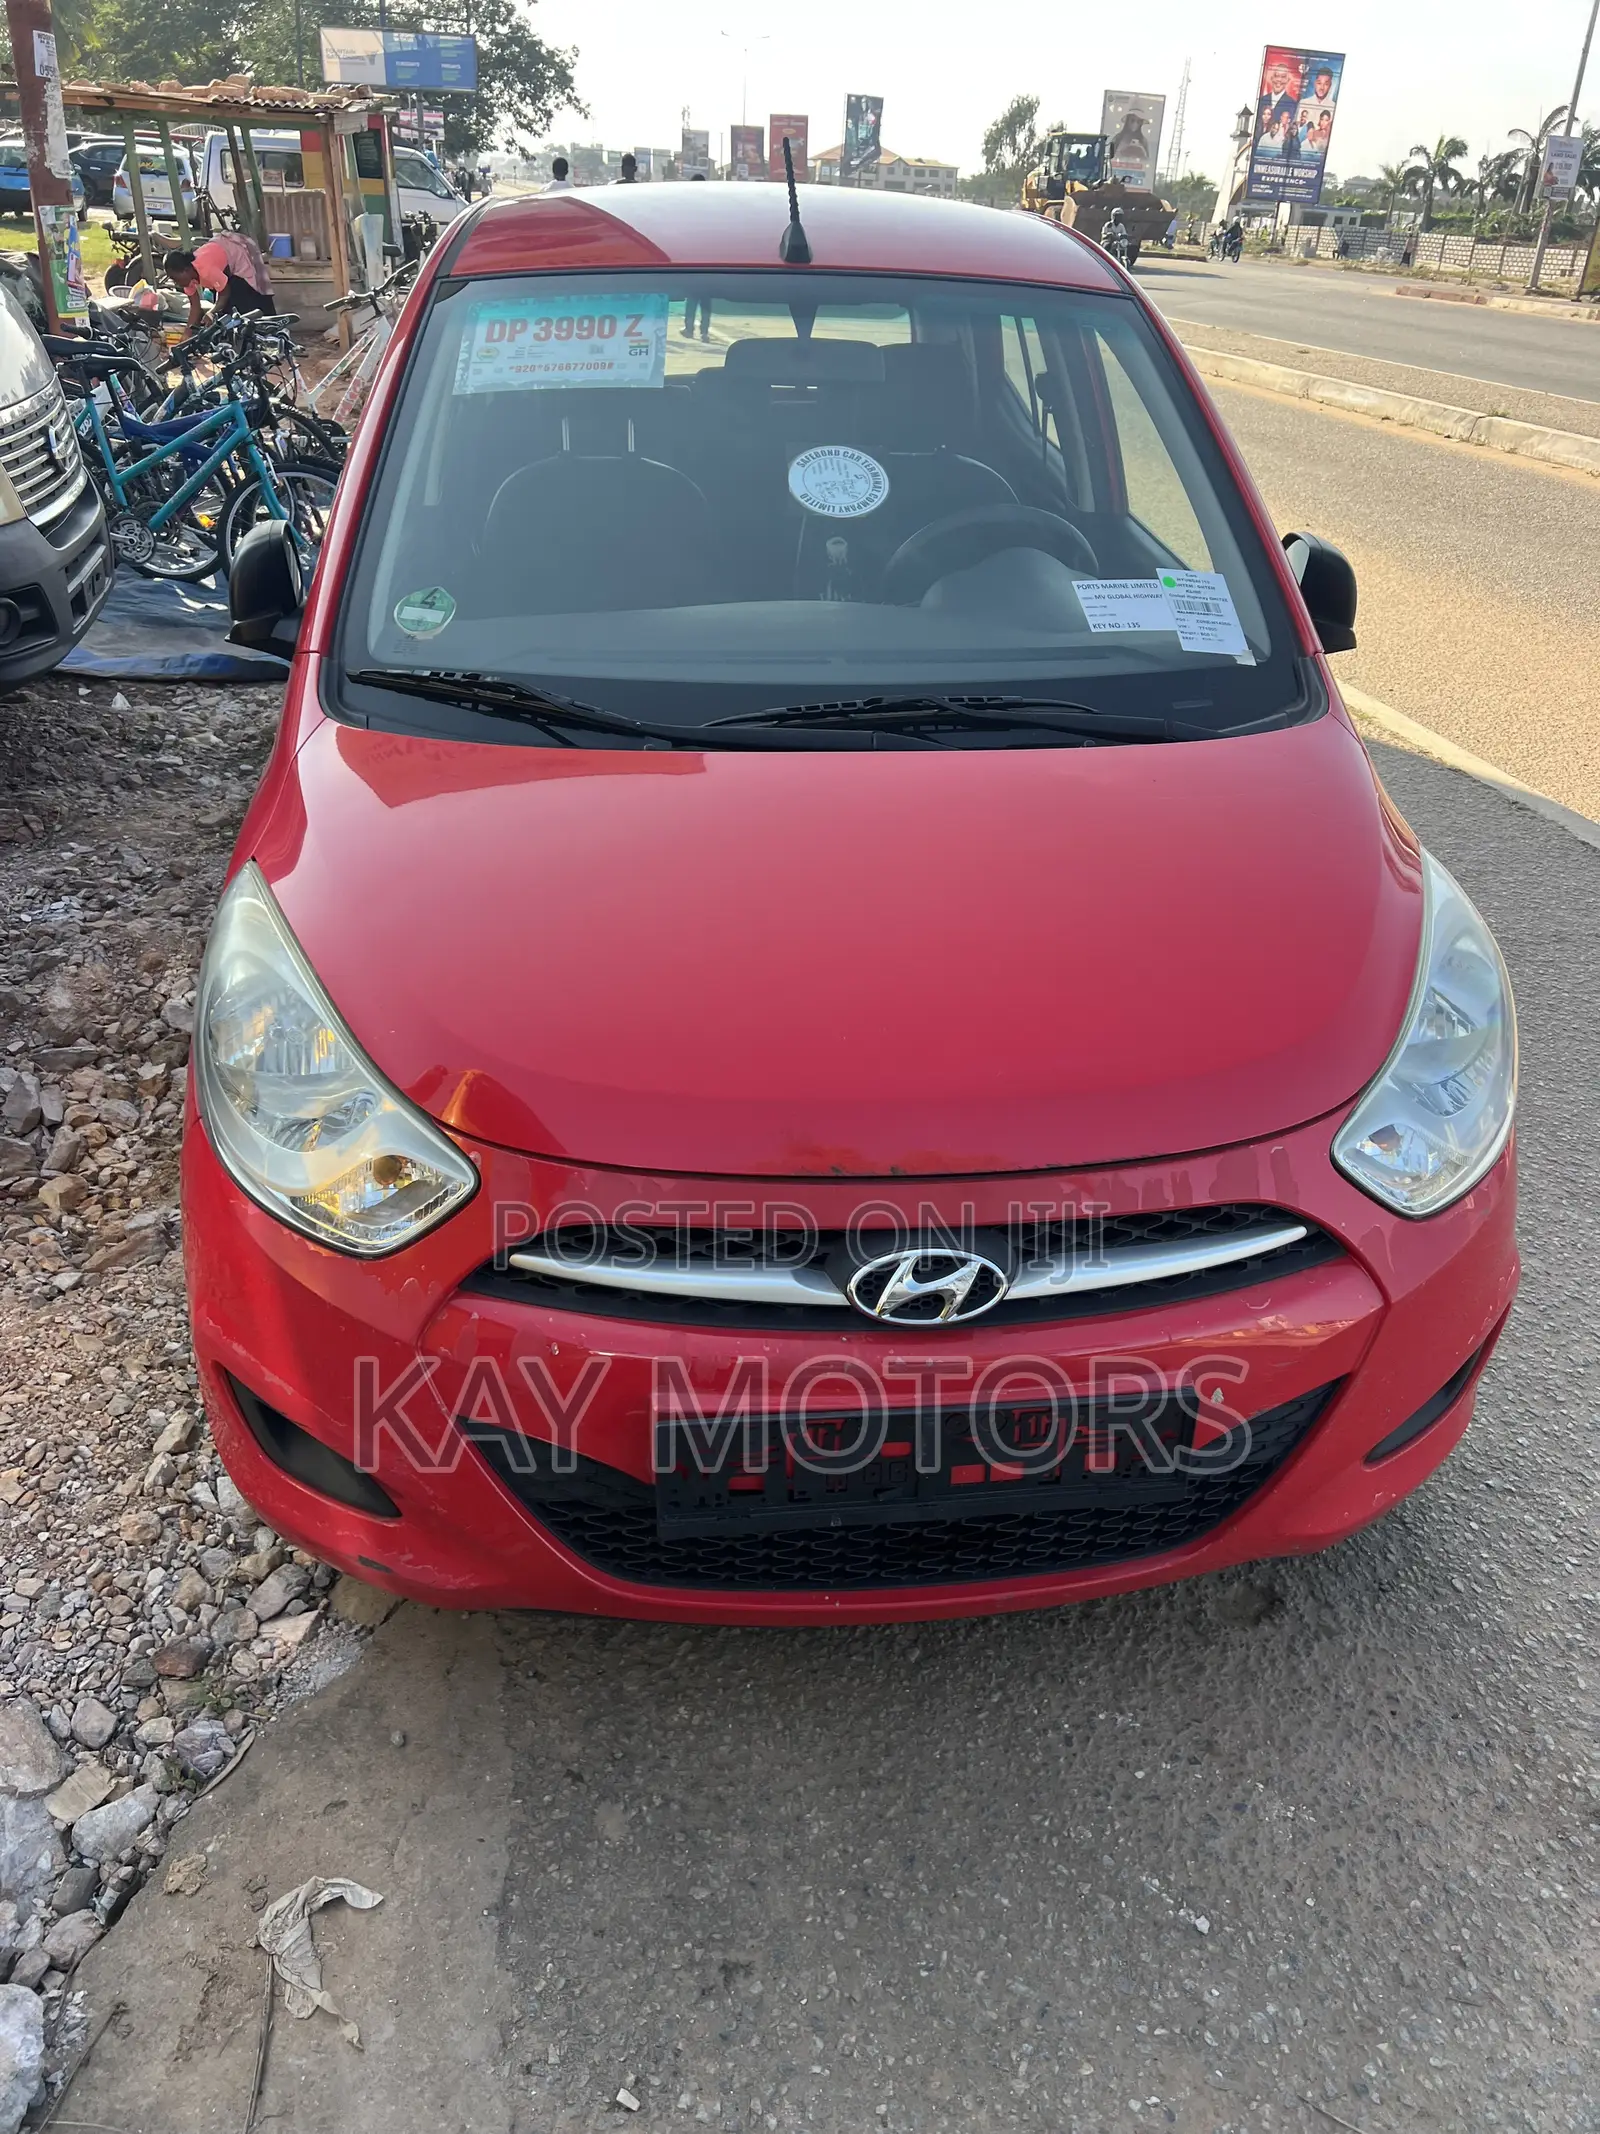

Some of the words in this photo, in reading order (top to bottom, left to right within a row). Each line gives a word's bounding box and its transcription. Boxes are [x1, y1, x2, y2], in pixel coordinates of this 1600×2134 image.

[485, 318, 528, 344] DP
[533, 314, 617, 342] 3990
[623, 314, 645, 338] Z
[628, 348, 649, 357] GH
[796, 449, 840, 469] SAFEBOND
[842, 450, 863, 463] CAR
[861, 459, 883, 493] TERMINAL
[800, 492, 836, 513] LIMITED
[839, 492, 879, 514] COMPANY
[1092, 622, 1106, 630] KEY
